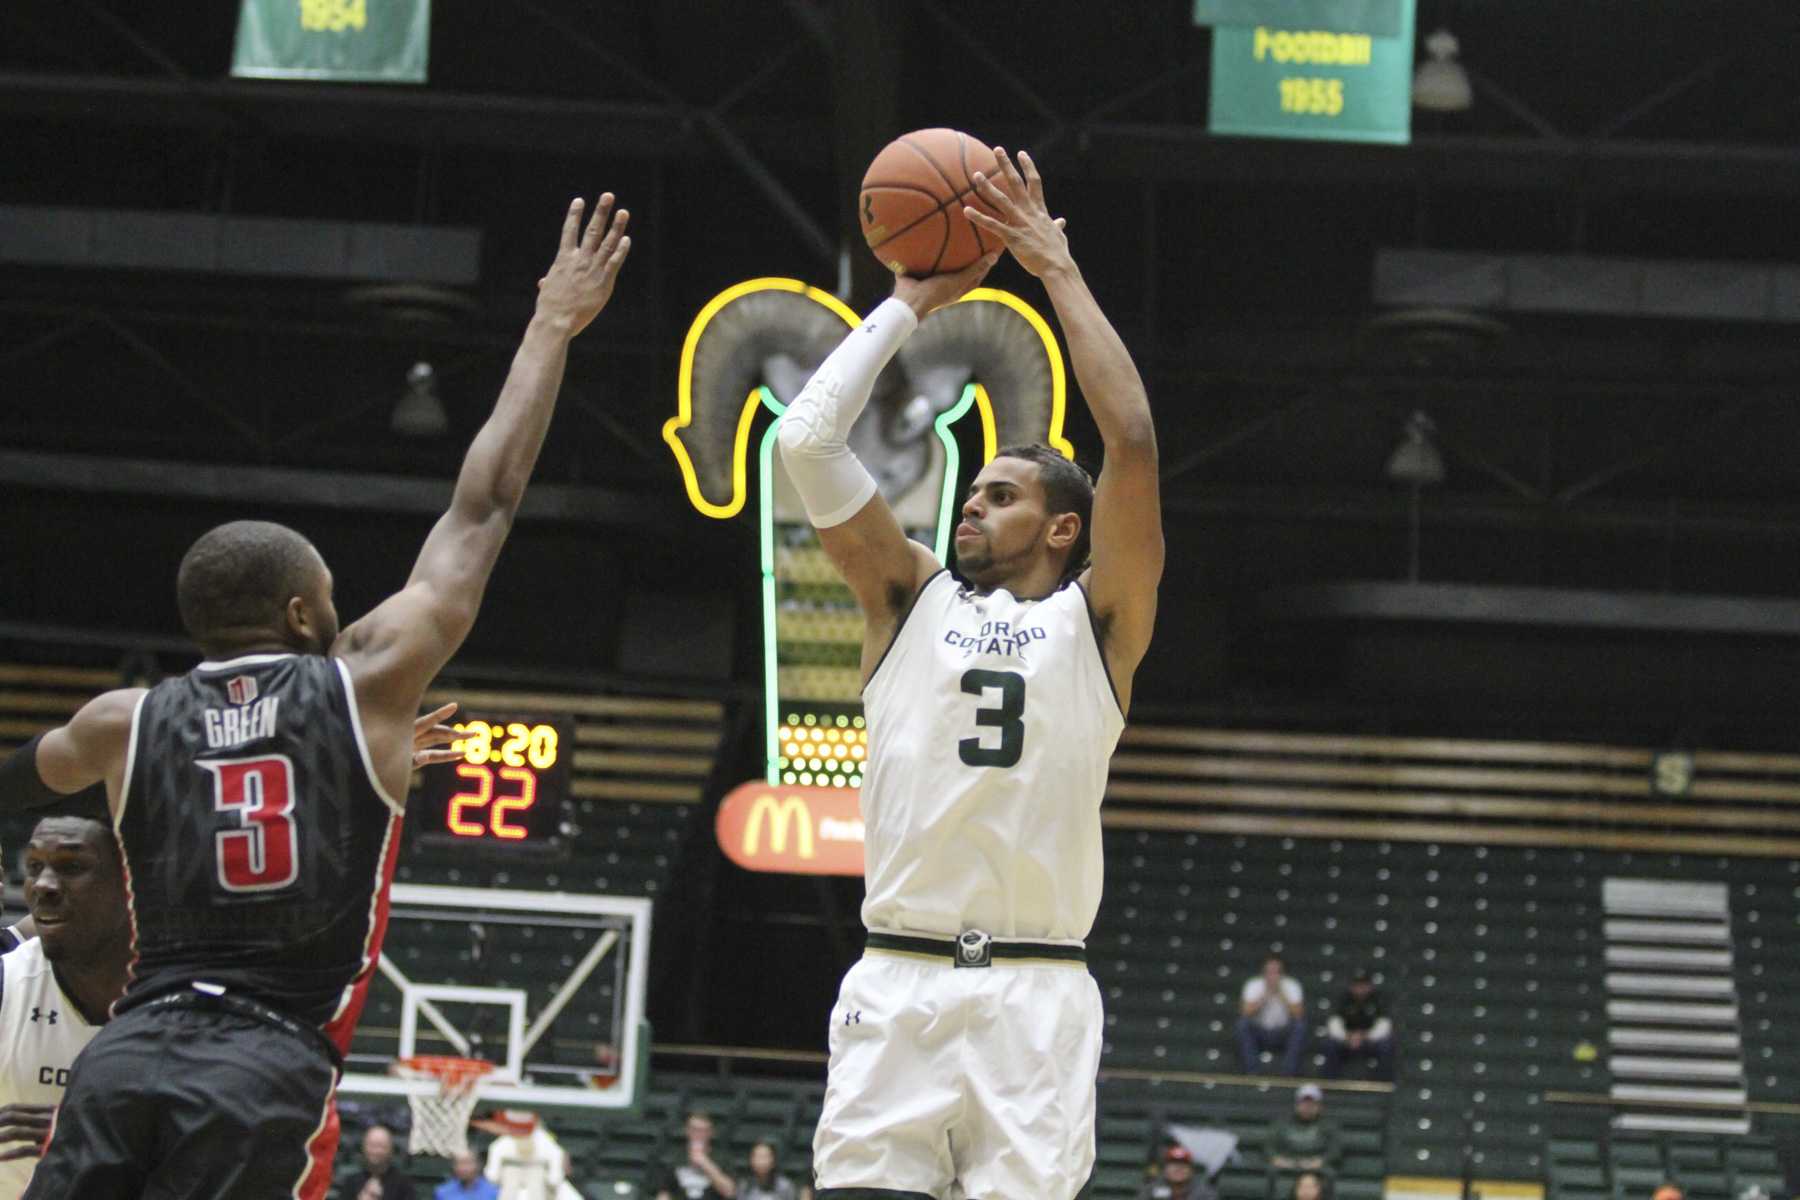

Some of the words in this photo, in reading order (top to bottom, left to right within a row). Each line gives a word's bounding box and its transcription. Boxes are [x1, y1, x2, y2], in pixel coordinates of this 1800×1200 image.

[1280, 79, 1344, 117] 1955
[204, 697, 279, 748] GREEN
[958, 669, 1026, 768] 3
[193, 754, 299, 893] 3
[448, 764, 536, 839] 22
